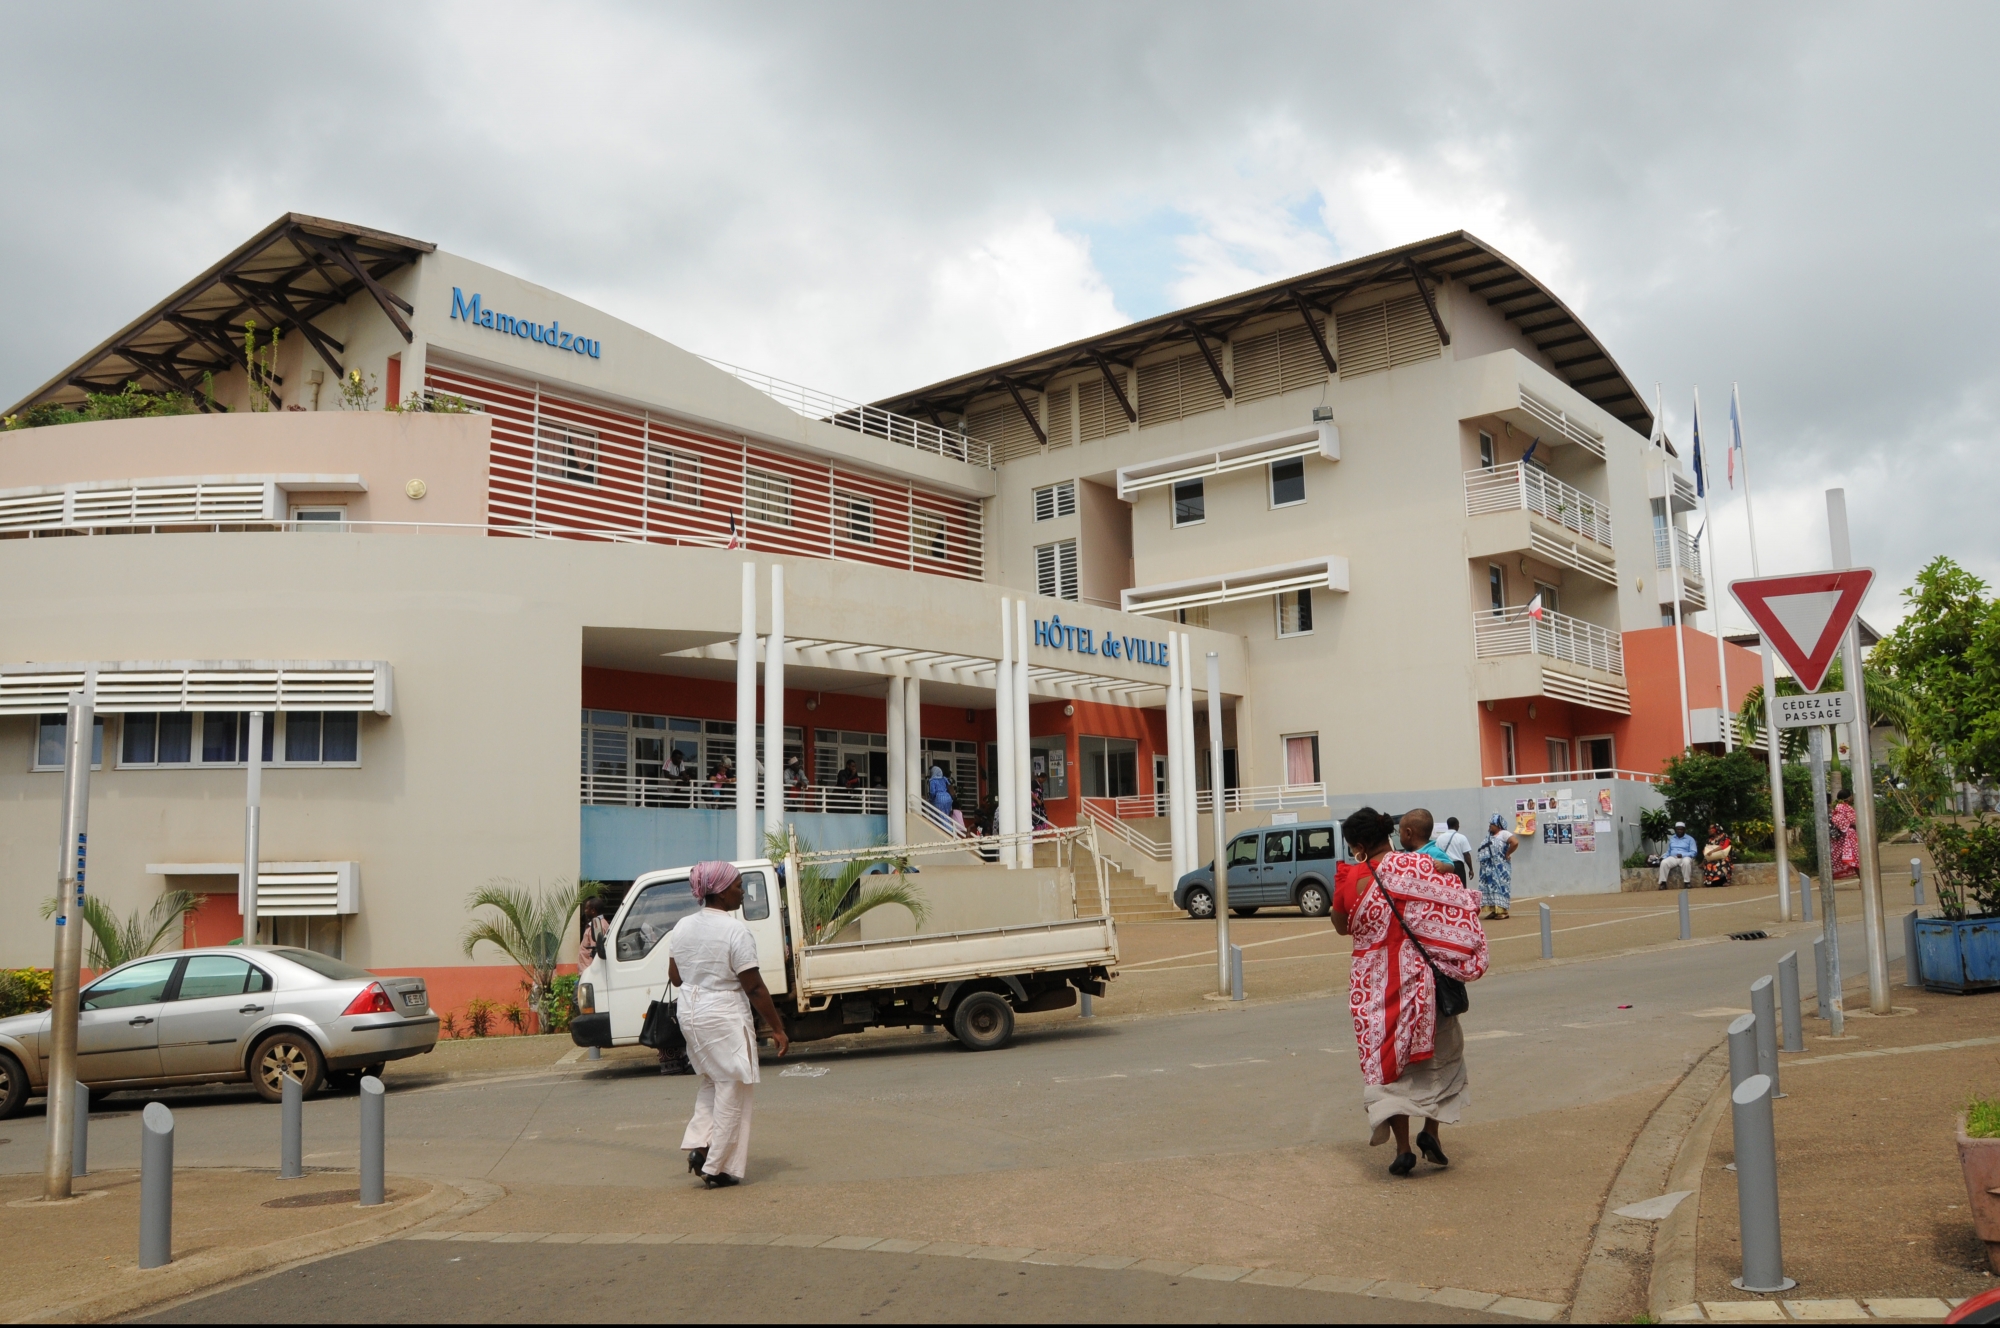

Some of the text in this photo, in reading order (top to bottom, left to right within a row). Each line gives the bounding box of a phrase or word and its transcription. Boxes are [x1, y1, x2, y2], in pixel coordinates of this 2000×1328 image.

[450, 286, 600, 359] Mamoudzou
[1034, 614, 1169, 666] HÔTEL de VILLE
[1782, 698, 1841, 710] CÉDEZ LE
[1785, 709, 1842, 721] PASSAGE
